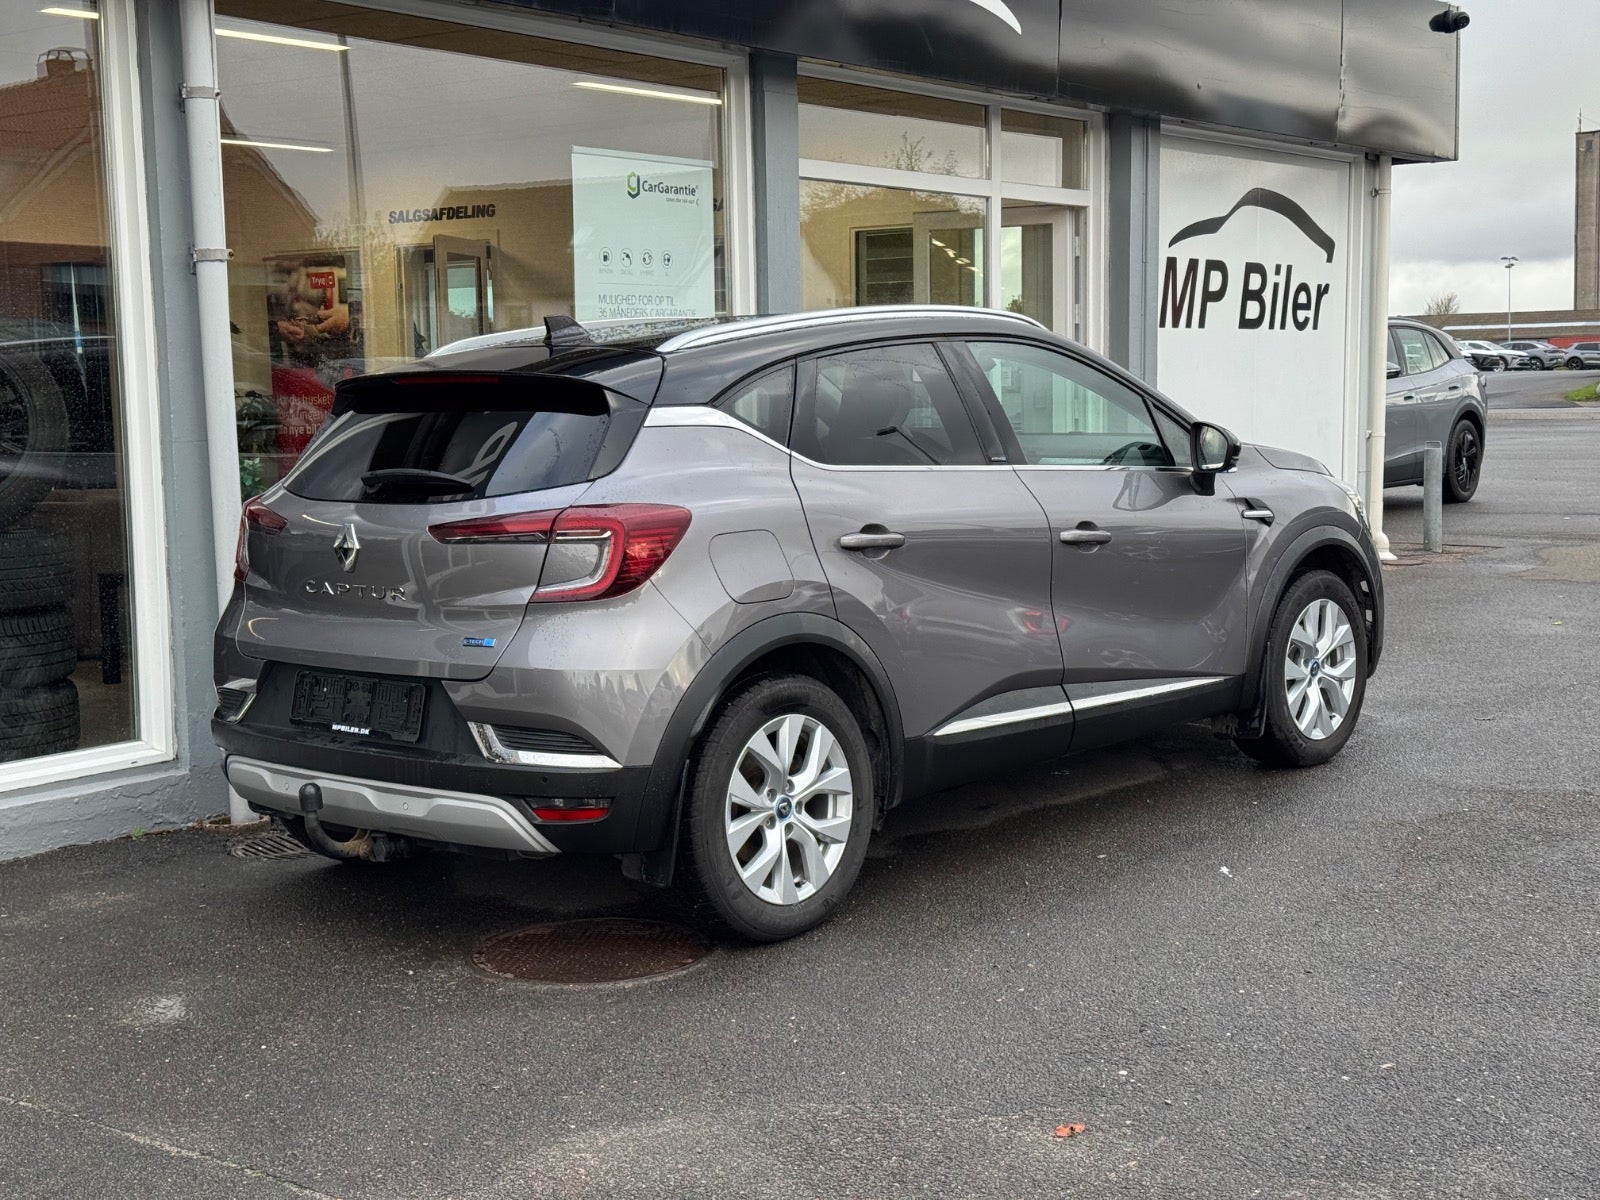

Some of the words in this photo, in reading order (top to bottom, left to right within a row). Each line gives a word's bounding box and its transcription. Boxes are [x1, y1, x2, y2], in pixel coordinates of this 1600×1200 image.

[388, 203, 497, 224] SALGSAFDELING
[598, 294, 637, 306] MULIGHED
[638, 295, 653, 306] FOR
[655, 295, 665, 306] OP
[666, 296, 676, 306] TIL
[1159, 256, 1229, 329] MP
[1238, 261, 1331, 331] Biler
[599, 307, 608, 318] 36
[609, 304, 649, 318] MÅNEDERS
[305, 580, 406, 602] CAPTUR
